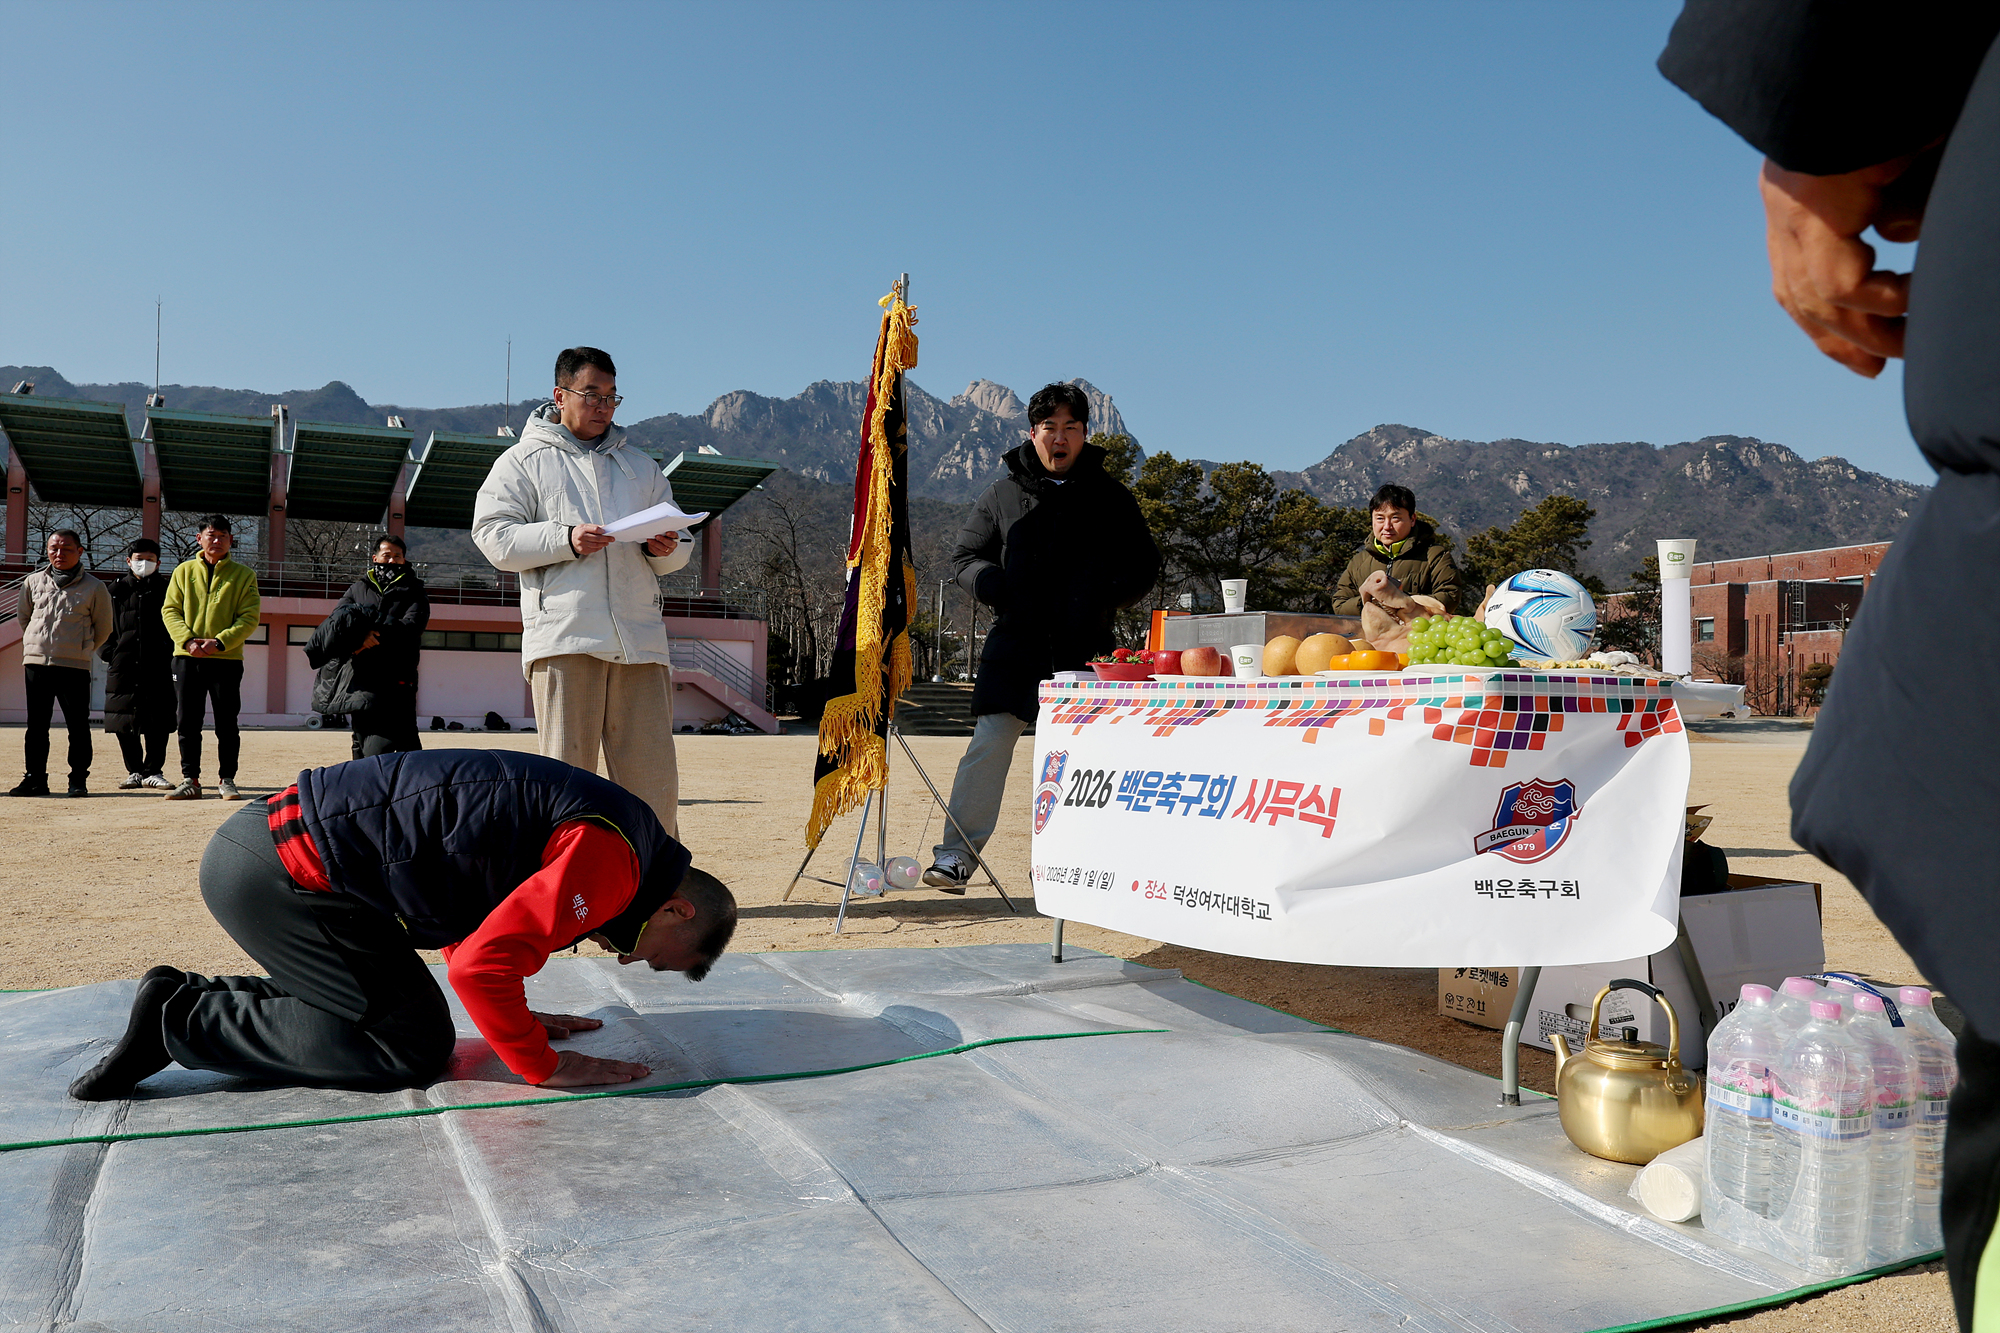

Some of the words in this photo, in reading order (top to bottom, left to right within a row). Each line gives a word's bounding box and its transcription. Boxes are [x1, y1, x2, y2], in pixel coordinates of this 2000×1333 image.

[1063, 768, 1117, 809] 2026
[1115, 769, 1238, 820] 백운축구회
[1231, 778, 1342, 839] 시무식
[1489, 828, 1530, 842] BAEGUN
[1512, 843, 1536, 851] 1979
[1067, 867, 1082, 886] 2월
[1474, 878, 1581, 900] 백운축구회
[572, 893, 589, 923] 백운
[1144, 879, 1168, 901] 장소
[1173, 885, 1273, 921] 덕성여자대학교
[1468, 967, 1509, 988] 로켓배송
